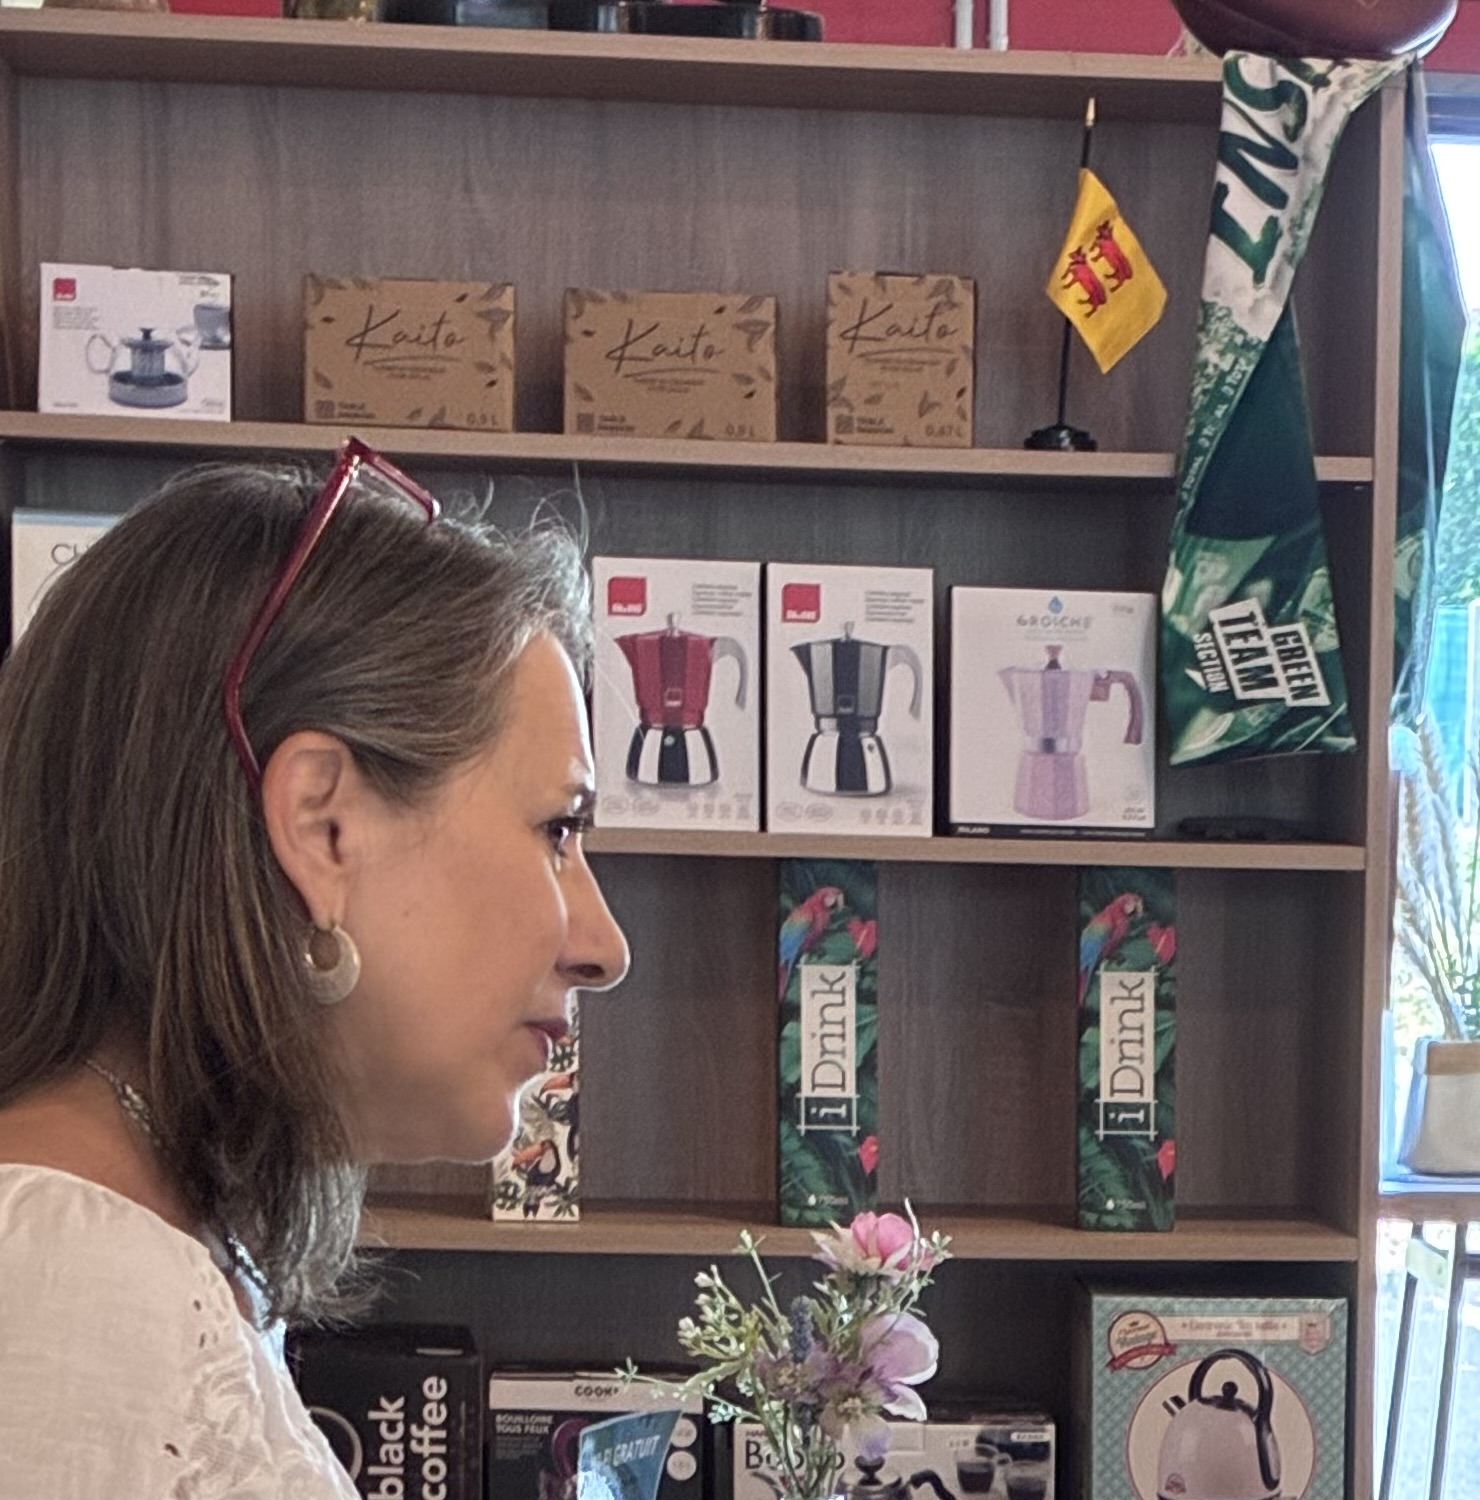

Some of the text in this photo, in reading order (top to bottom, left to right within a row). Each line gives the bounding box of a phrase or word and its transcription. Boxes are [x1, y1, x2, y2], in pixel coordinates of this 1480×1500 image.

[344, 304, 470, 364] Kaito
[606, 319, 725, 375] Kaito
[838, 299, 962, 354] Kaito
[1192, 631, 1230, 694] SECTION
[1218, 610, 1279, 692] TEAM
[1271, 630, 1322, 700] GREEN
[810, 969, 849, 1094] Drink
[1110, 977, 1147, 1097] Drink
